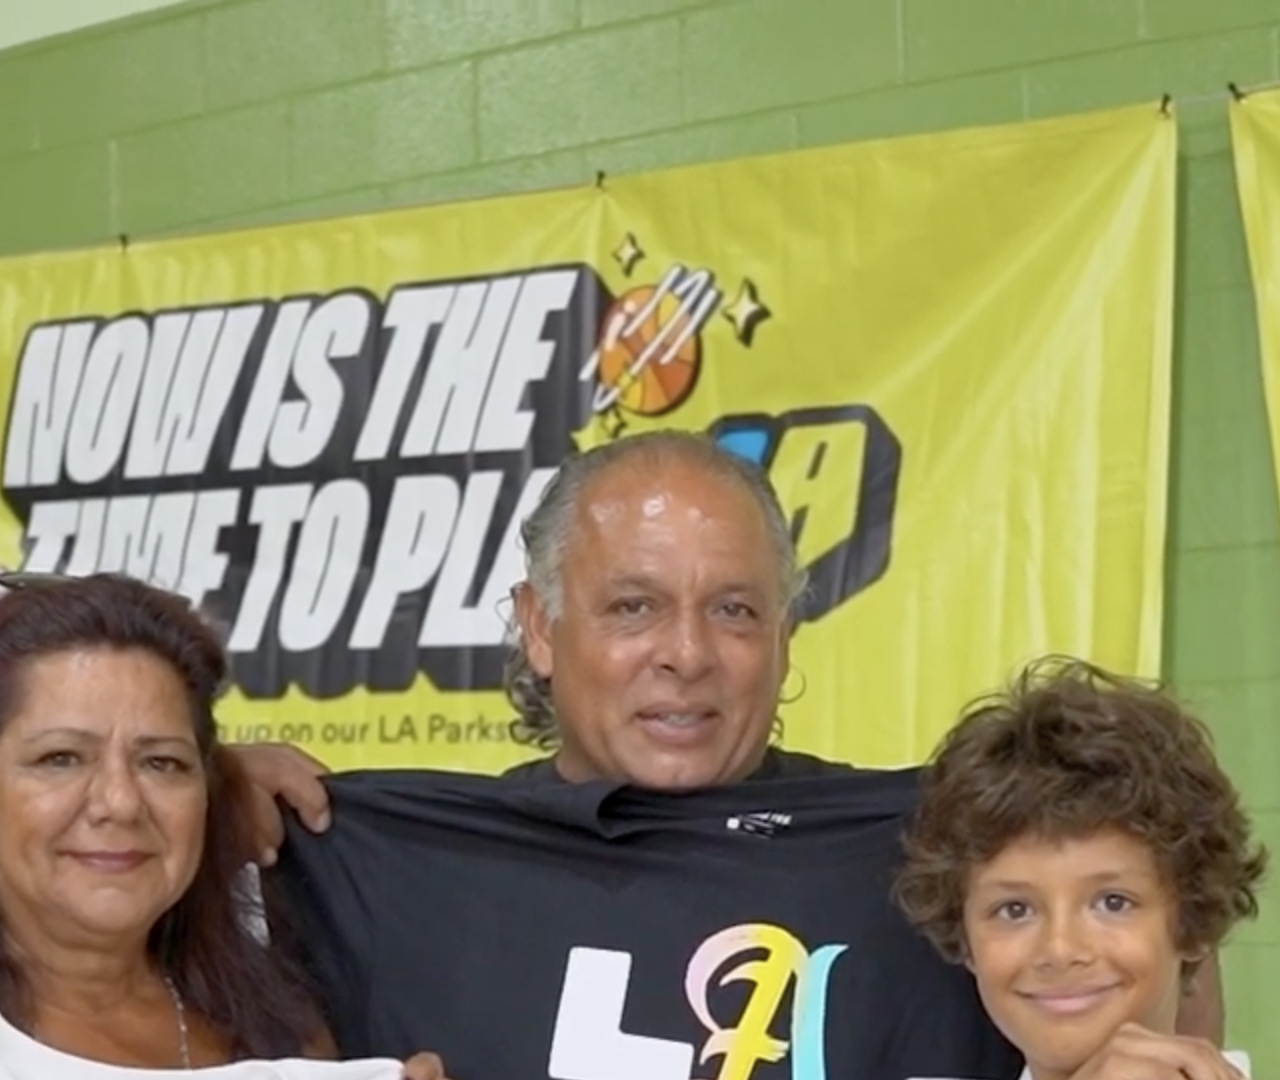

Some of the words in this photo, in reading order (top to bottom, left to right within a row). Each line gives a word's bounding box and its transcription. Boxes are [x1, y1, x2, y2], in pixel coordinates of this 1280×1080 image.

[4, 305, 265, 488] NOW
[229, 292, 371, 471] IS
[352, 270, 579, 461] THE
[227, 478, 370, 653] TO
[279, 722, 314, 743] on
[322, 720, 368, 744] our
[378, 715, 419, 744] LA
[428, 714, 508, 744] Parks
